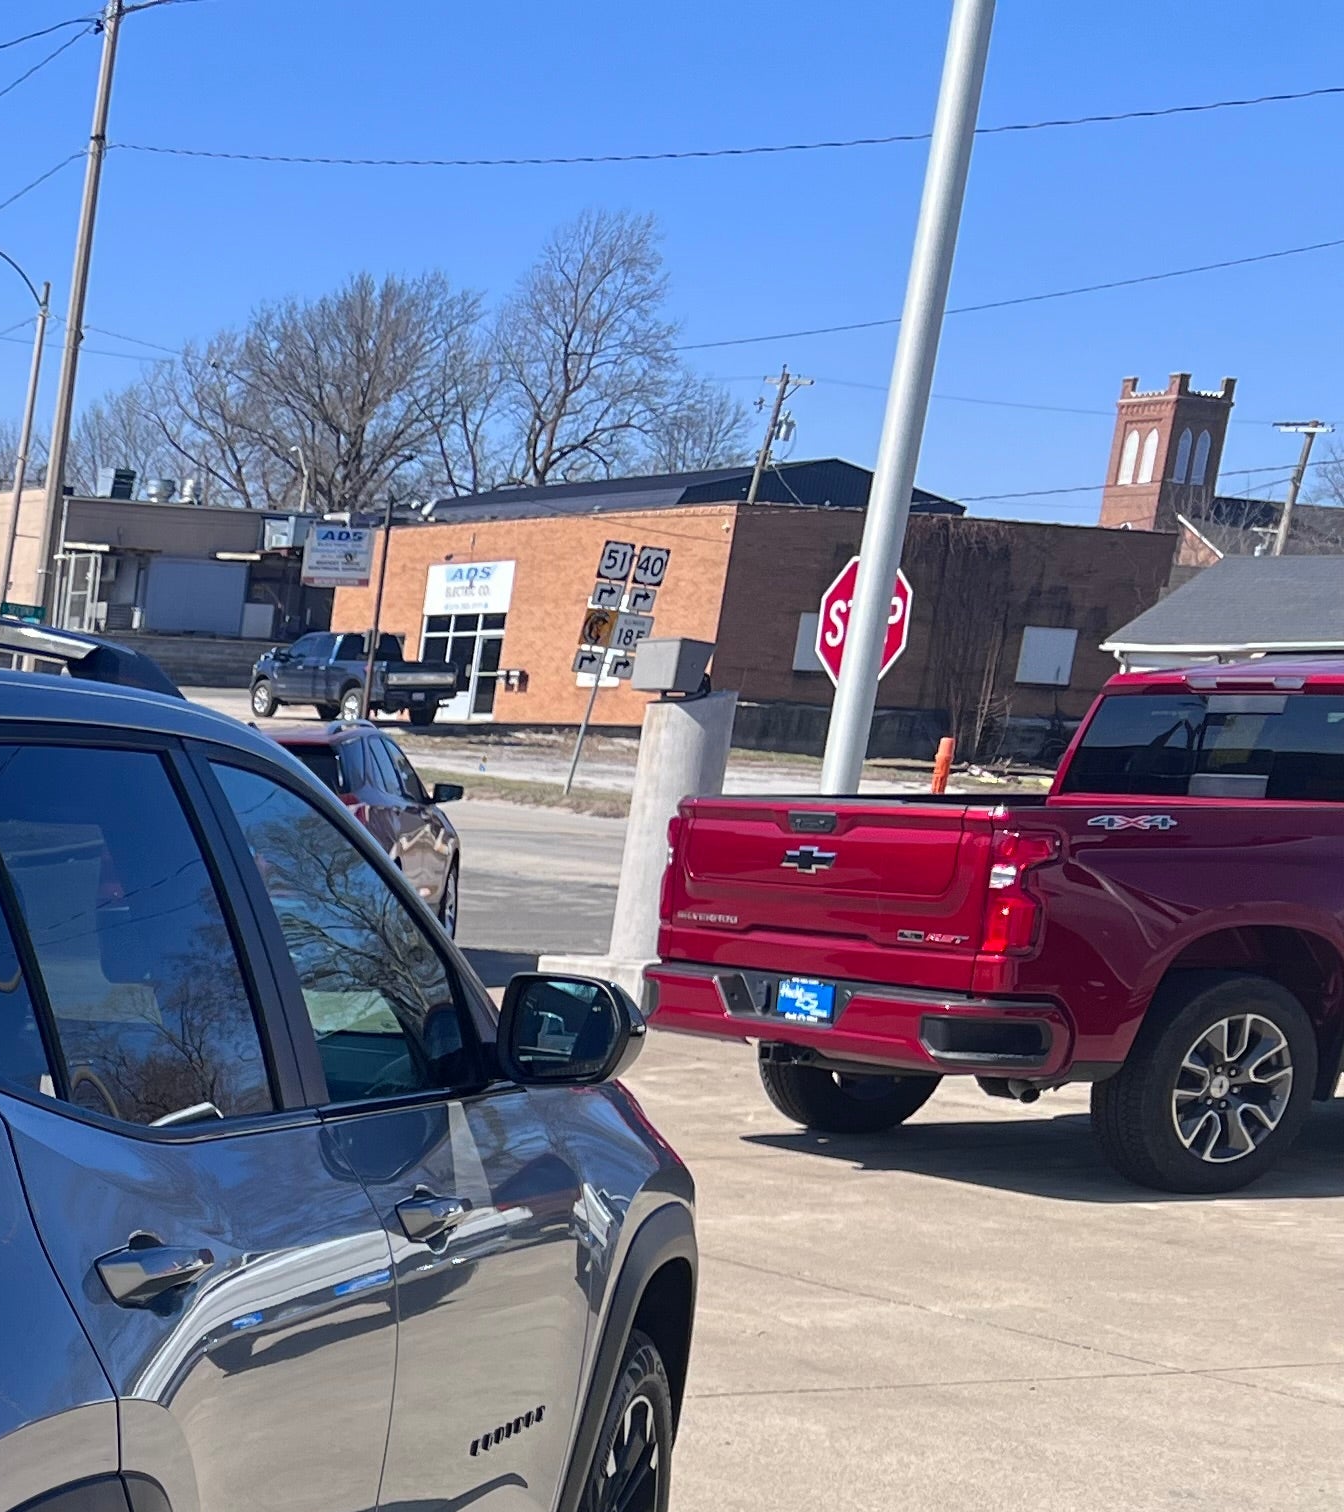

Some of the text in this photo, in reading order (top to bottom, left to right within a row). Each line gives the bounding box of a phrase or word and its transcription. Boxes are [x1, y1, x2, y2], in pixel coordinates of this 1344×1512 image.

[321, 530, 363, 542] ADS
[604, 549, 628, 572] 51
[638, 555, 664, 578] 40
[451, 566, 492, 581] ADS
[825, 596, 904, 647] SP
